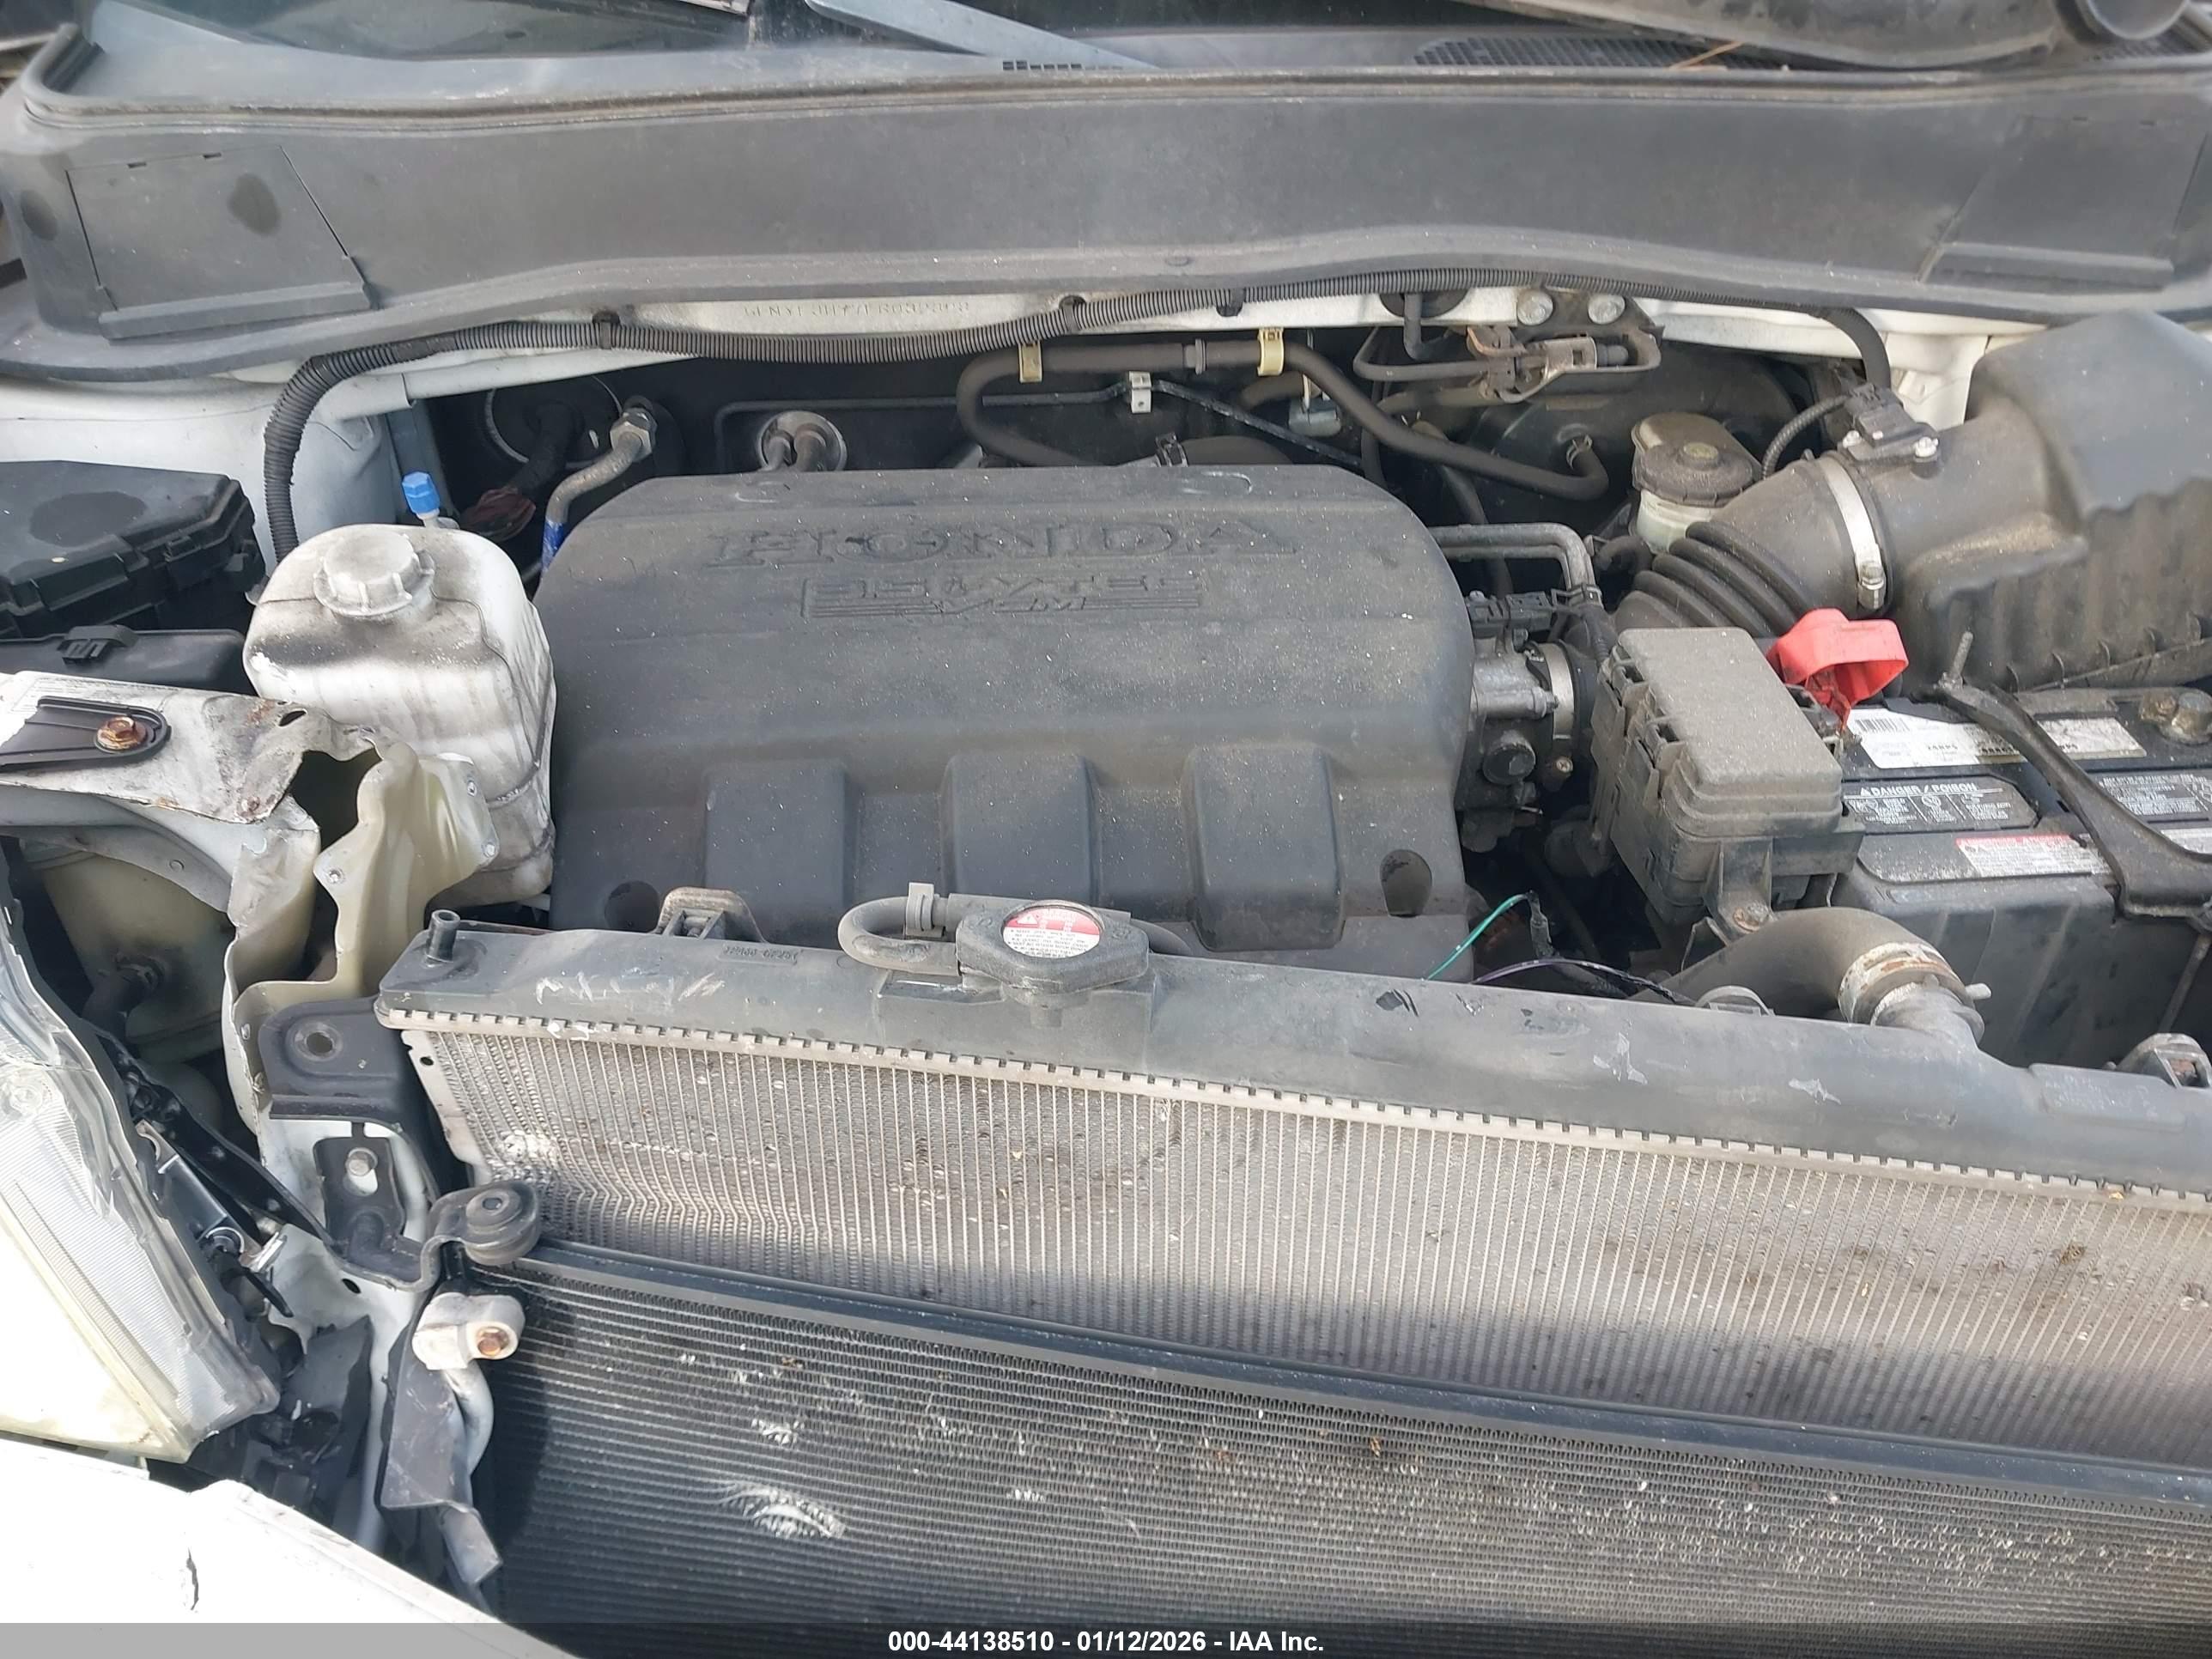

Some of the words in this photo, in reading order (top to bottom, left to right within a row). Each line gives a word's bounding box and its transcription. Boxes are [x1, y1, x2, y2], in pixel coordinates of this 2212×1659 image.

[706, 521, 1298, 568] HONDA
[1870, 785, 1921, 796] DANGER
[1932, 783, 1978, 793] POISON
